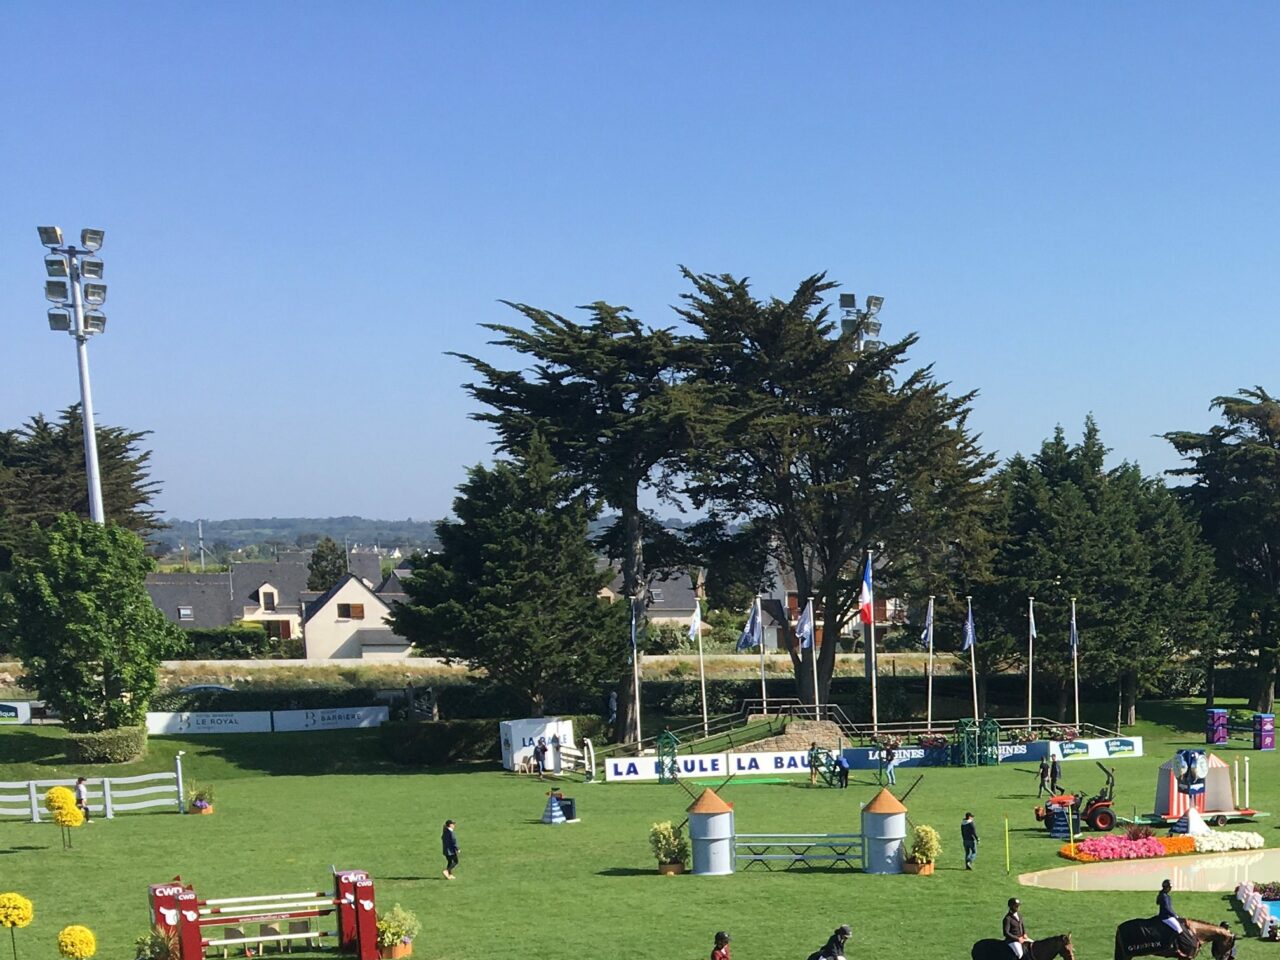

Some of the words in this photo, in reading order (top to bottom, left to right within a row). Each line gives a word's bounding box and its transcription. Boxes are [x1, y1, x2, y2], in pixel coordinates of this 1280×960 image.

[522, 737, 535, 747] LA
[868, 749, 925, 760] LOGINES
[613, 762, 639, 777] LA
[736, 757, 760, 771] LA
